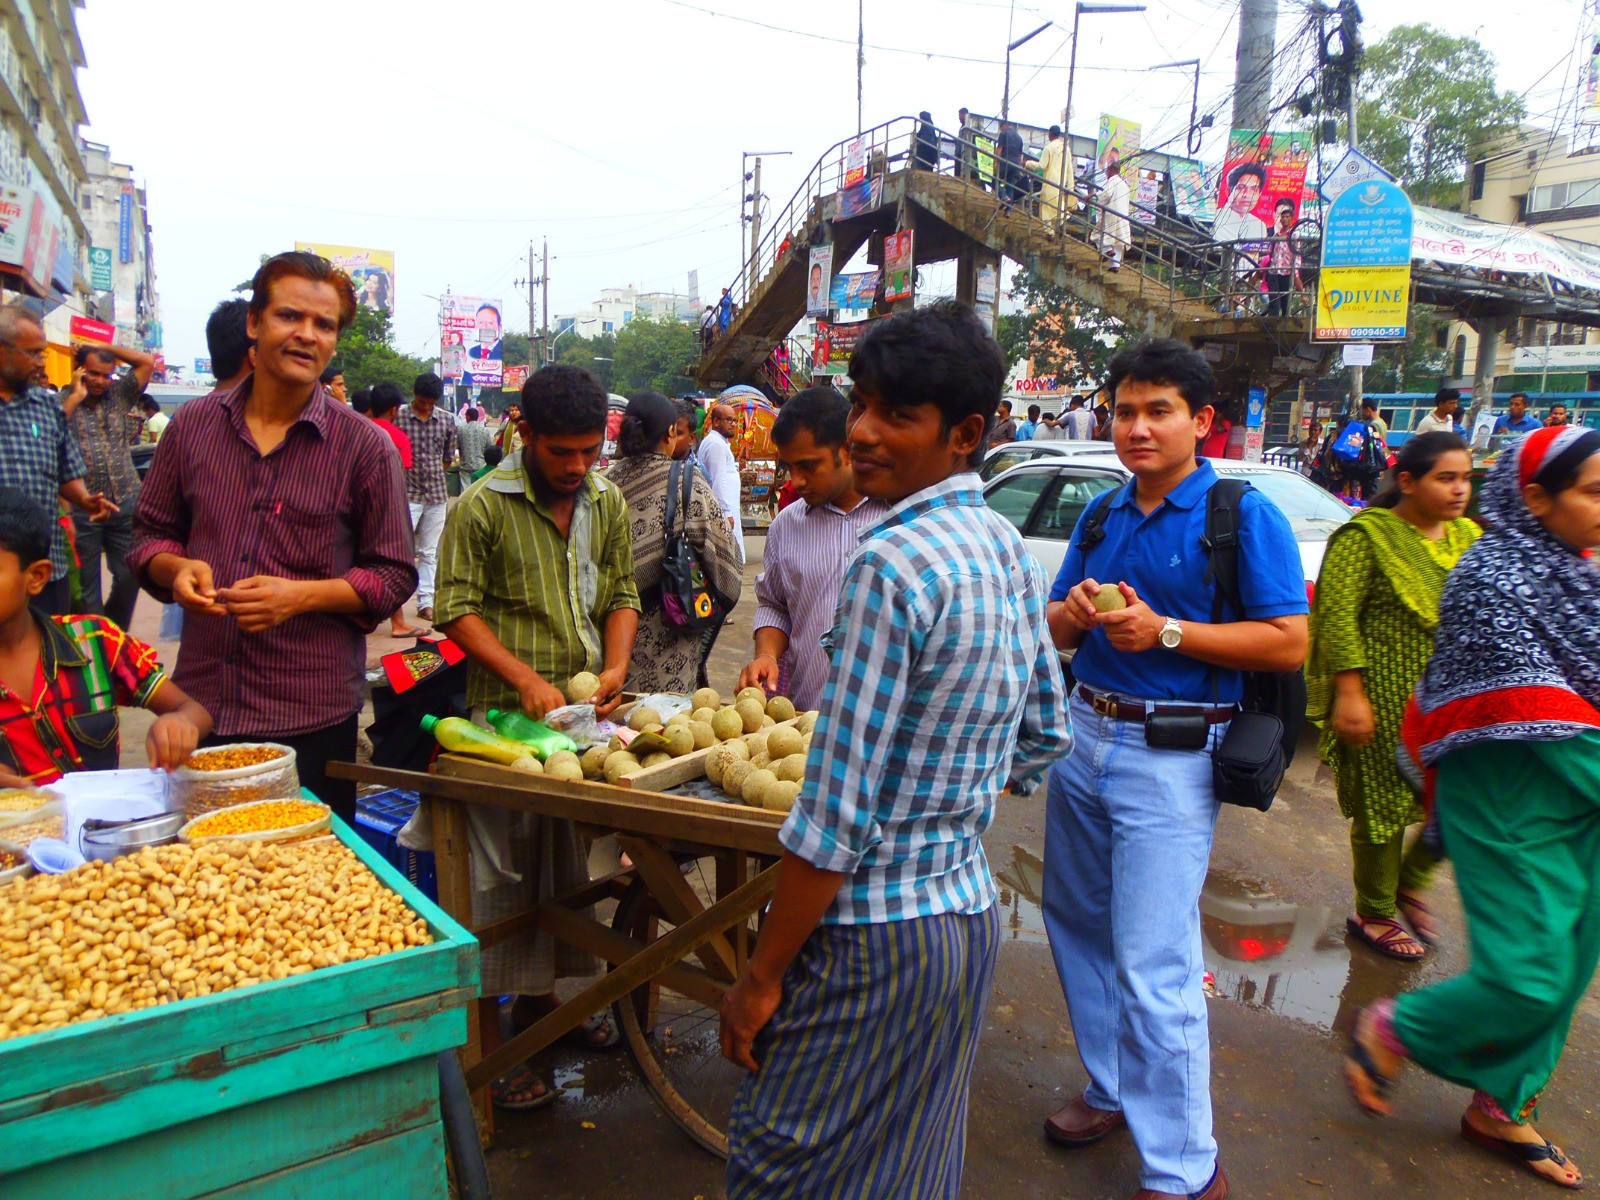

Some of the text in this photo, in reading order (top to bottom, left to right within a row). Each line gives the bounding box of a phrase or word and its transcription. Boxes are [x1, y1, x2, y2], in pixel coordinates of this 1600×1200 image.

[1335, 207, 1355, 216] ট্রাফিক
[1473, 249, 1506, 263] শেখ
[1344, 289, 1402, 303] DIVINE
[1350, 328, 1400, 336] 090940-55
[1016, 379, 1047, 391] ROXY
